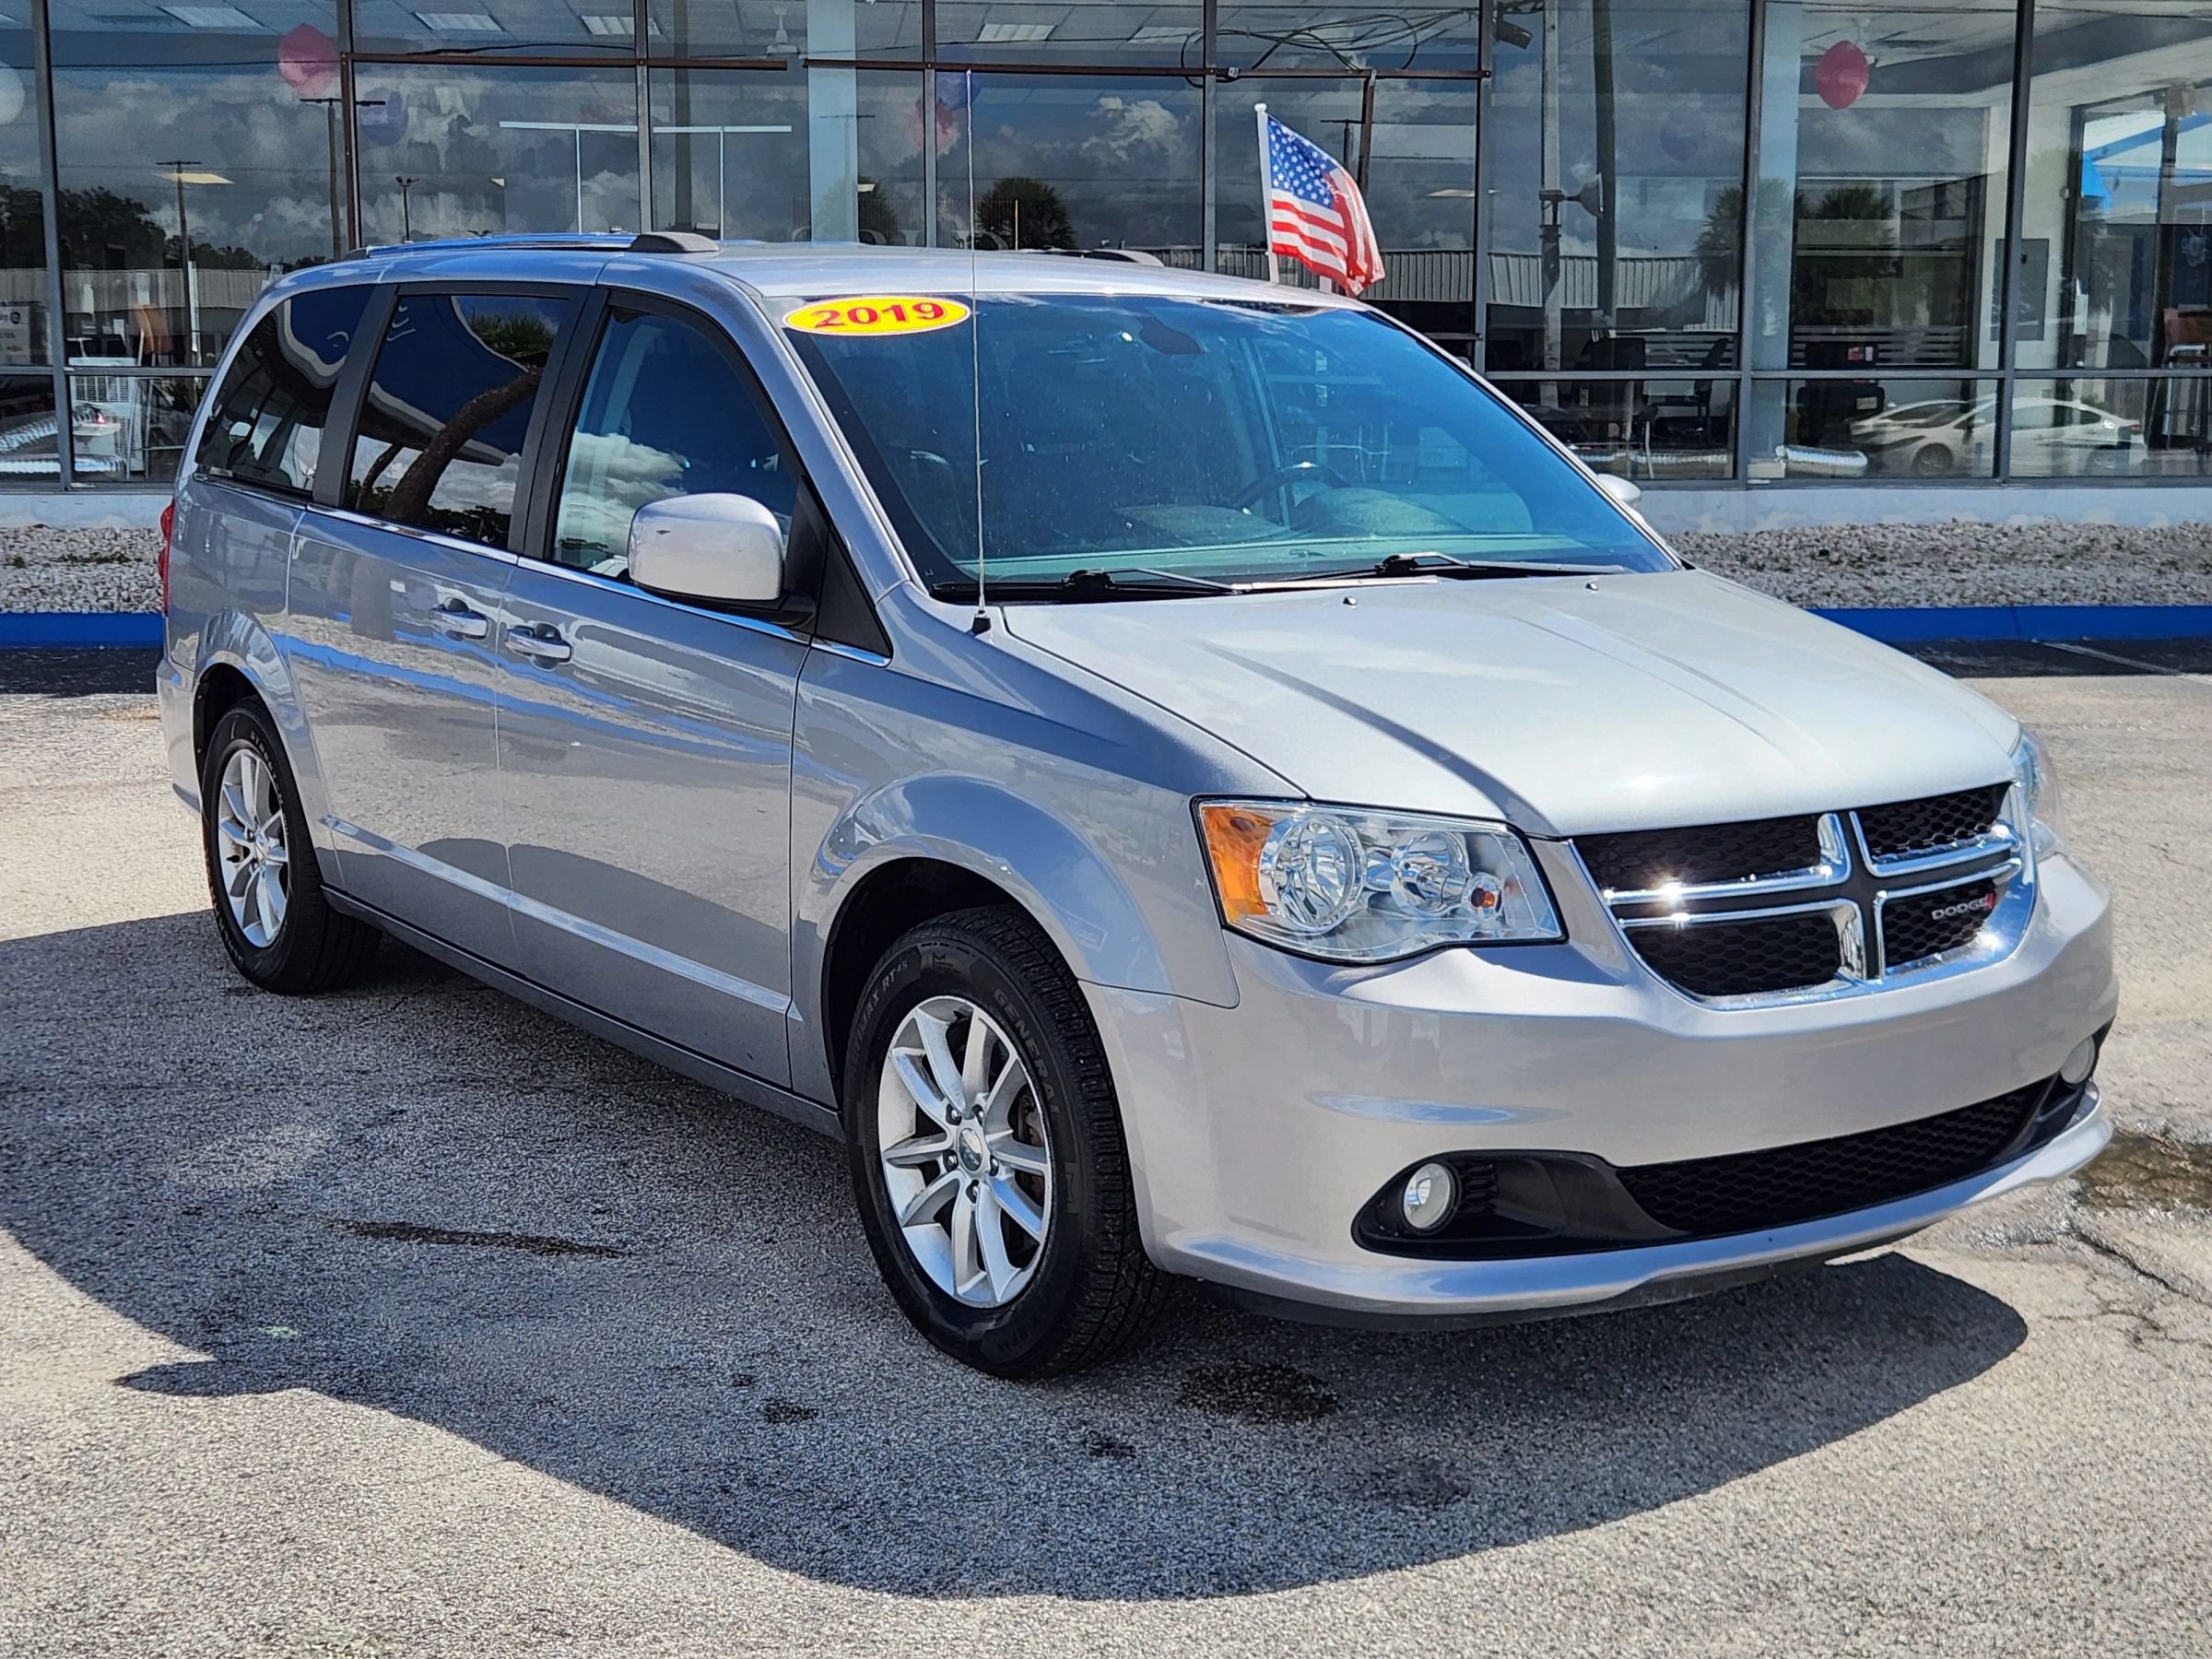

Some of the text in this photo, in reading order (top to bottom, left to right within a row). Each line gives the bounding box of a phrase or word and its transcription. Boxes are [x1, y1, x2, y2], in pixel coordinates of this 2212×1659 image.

[811, 302, 945, 328] 2019
[1931, 898, 1988, 921] DODGE
[993, 987, 1060, 1115] GENERAL
